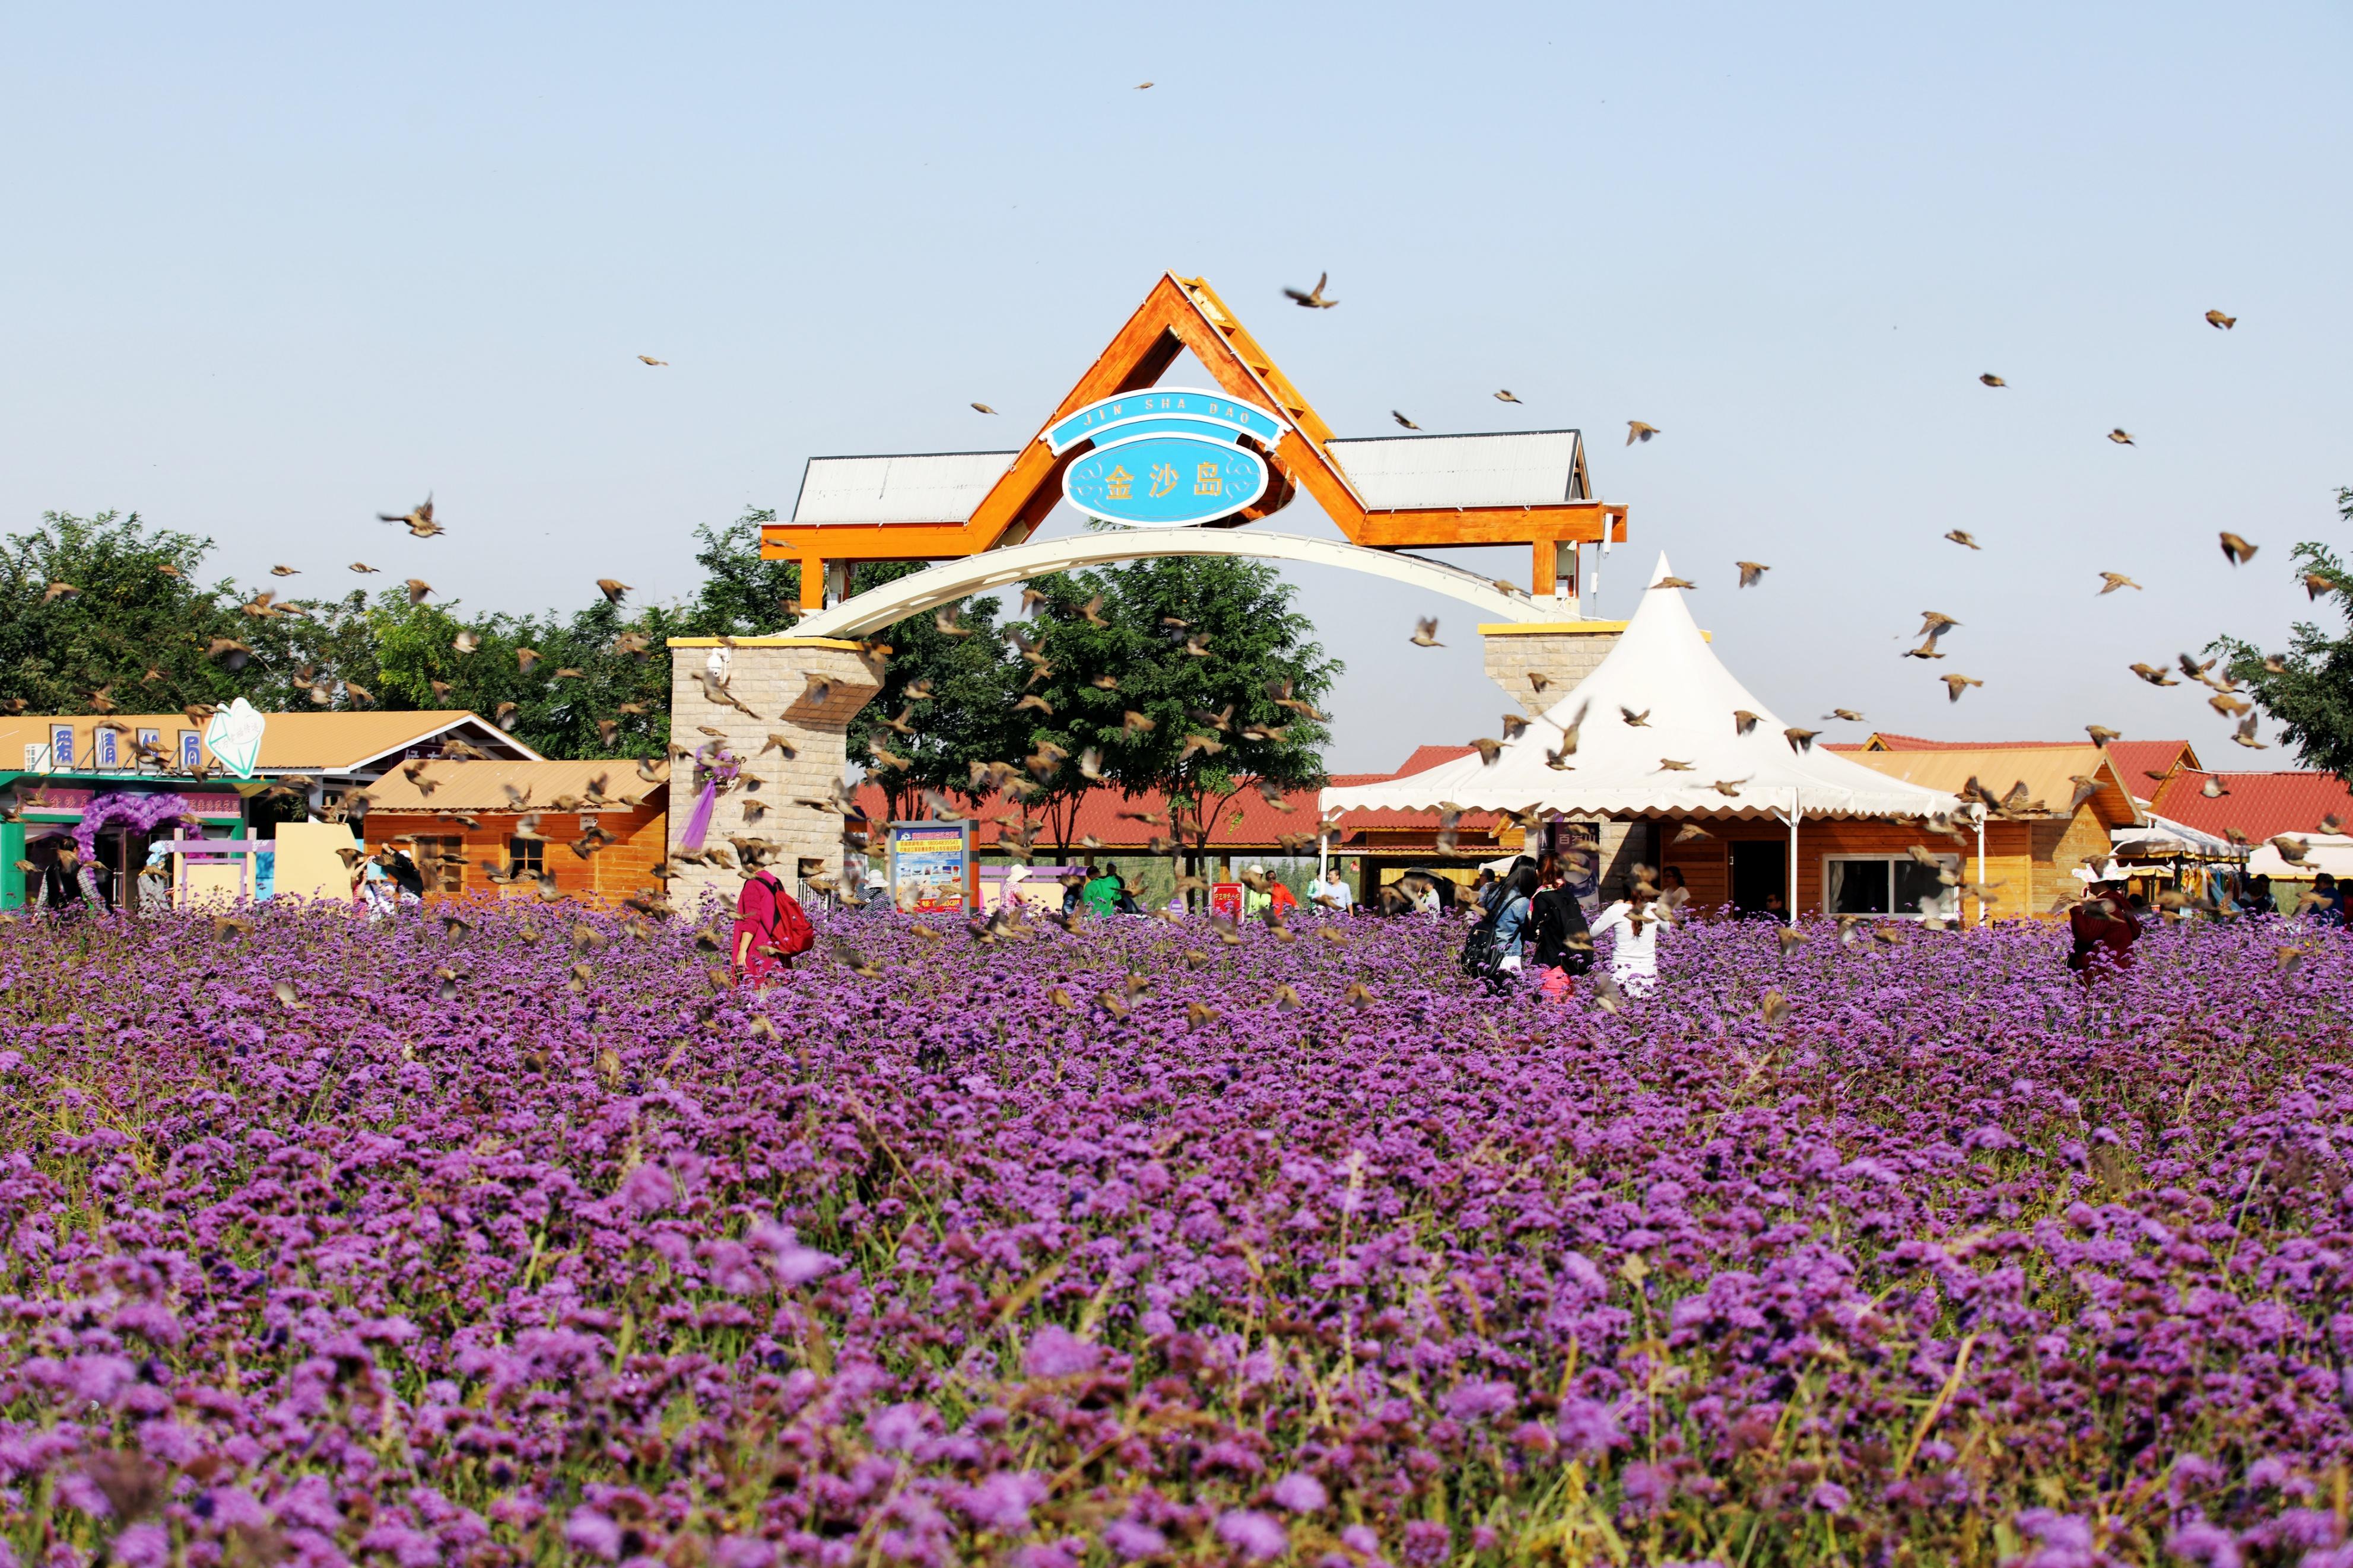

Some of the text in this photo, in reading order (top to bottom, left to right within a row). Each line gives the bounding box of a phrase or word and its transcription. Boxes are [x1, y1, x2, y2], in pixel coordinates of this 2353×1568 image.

[1084, 399, 1249, 425] JIN SHA DAO
[1105, 462, 1222, 500] 金沙岛
